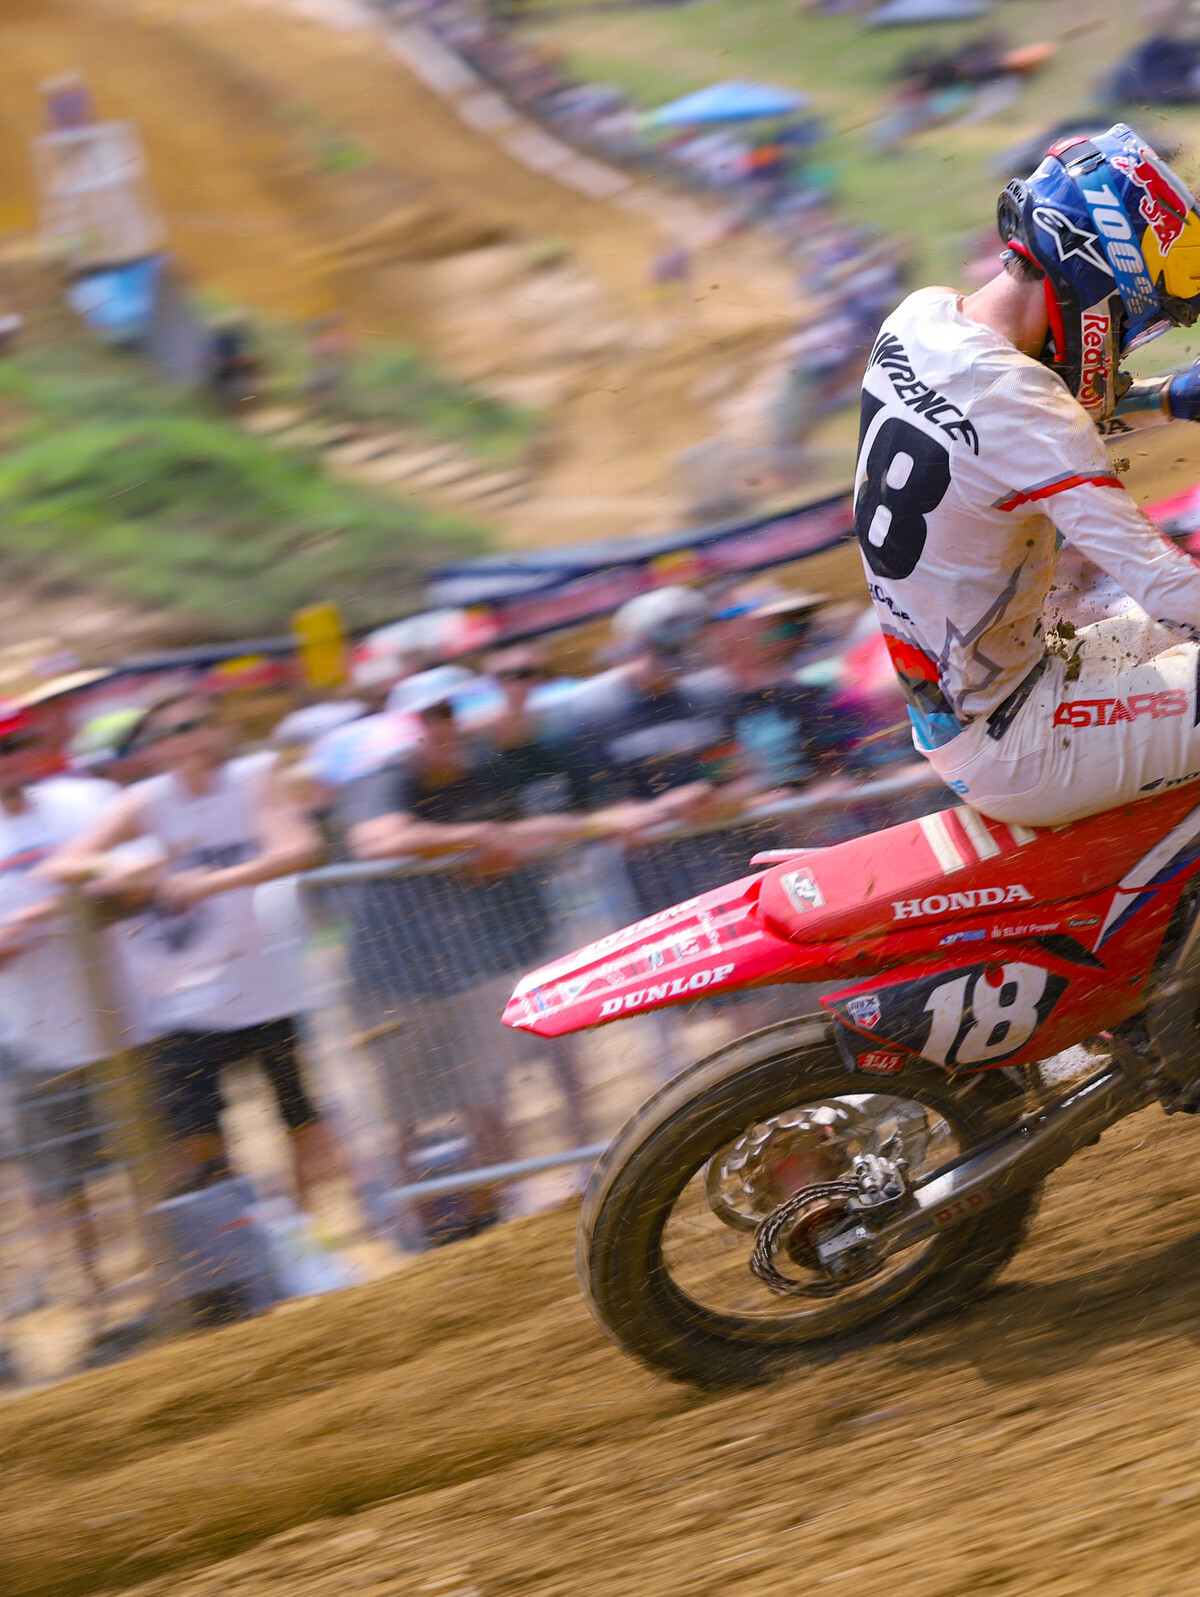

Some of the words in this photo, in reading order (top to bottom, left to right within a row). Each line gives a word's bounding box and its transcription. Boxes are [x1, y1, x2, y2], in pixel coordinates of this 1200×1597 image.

[866, 331, 979, 456] WRENCE
[1052, 689, 1188, 728] ASTARS
[891, 884, 1034, 921] HONDA
[599, 963, 736, 1017] DUNLOP
[919, 960, 1049, 1068] 18
